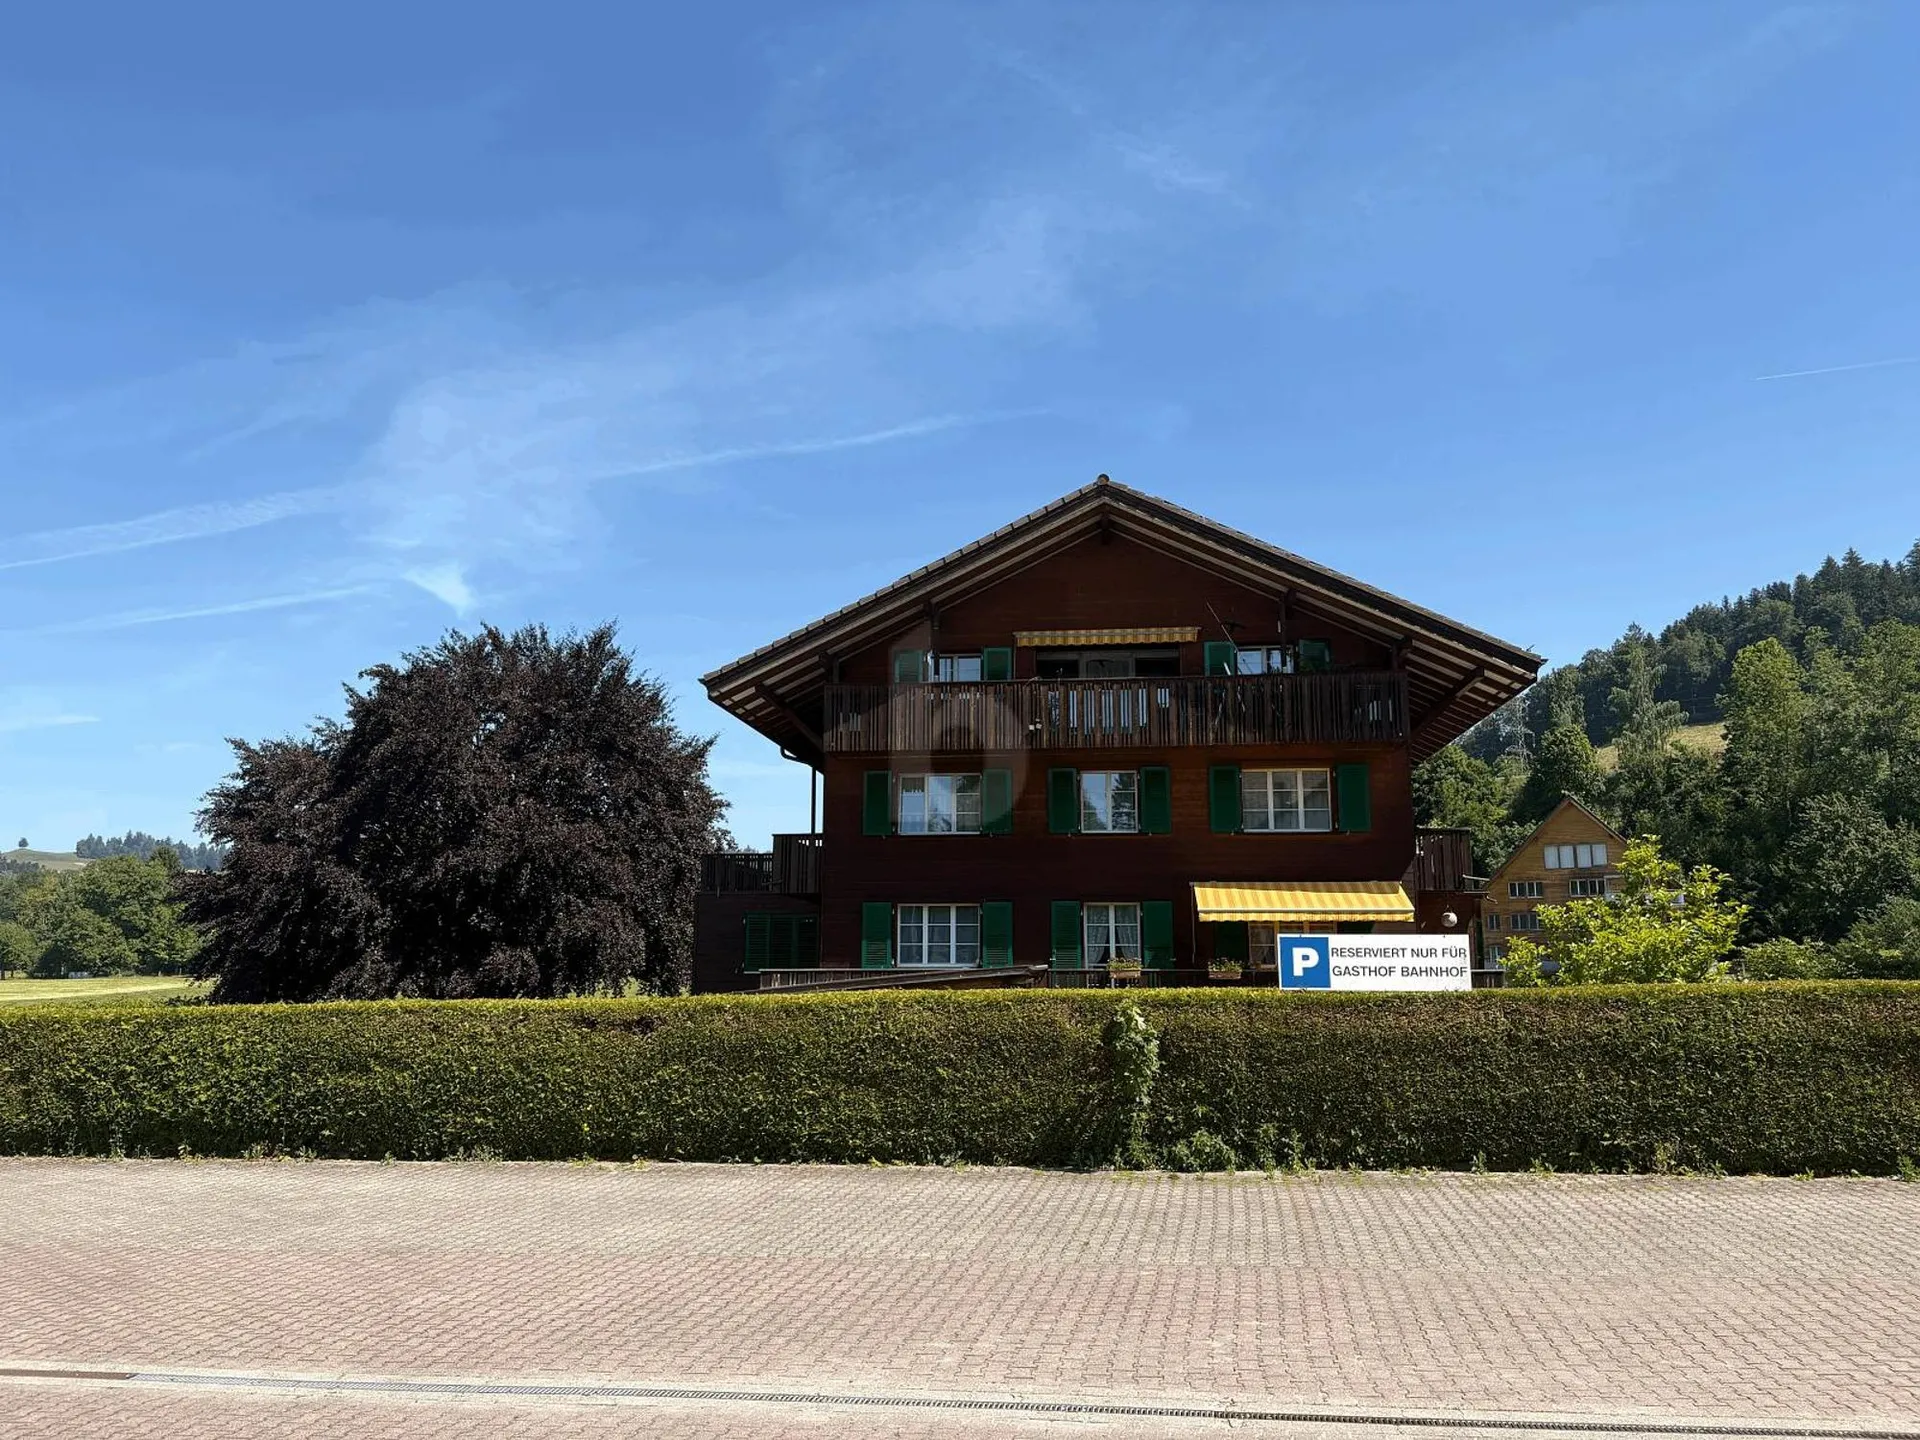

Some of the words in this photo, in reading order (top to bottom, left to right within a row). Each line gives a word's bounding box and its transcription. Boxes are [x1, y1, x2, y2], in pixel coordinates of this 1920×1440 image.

[1331, 947, 1408, 958] RESERVIERT
[1411, 947, 1438, 958] NUR
[1442, 945, 1467, 958] FÜR
[1292, 947, 1320, 977] P
[1332, 965, 1397, 977] GASTHOF
[1401, 966, 1468, 977] BAHNHOF
